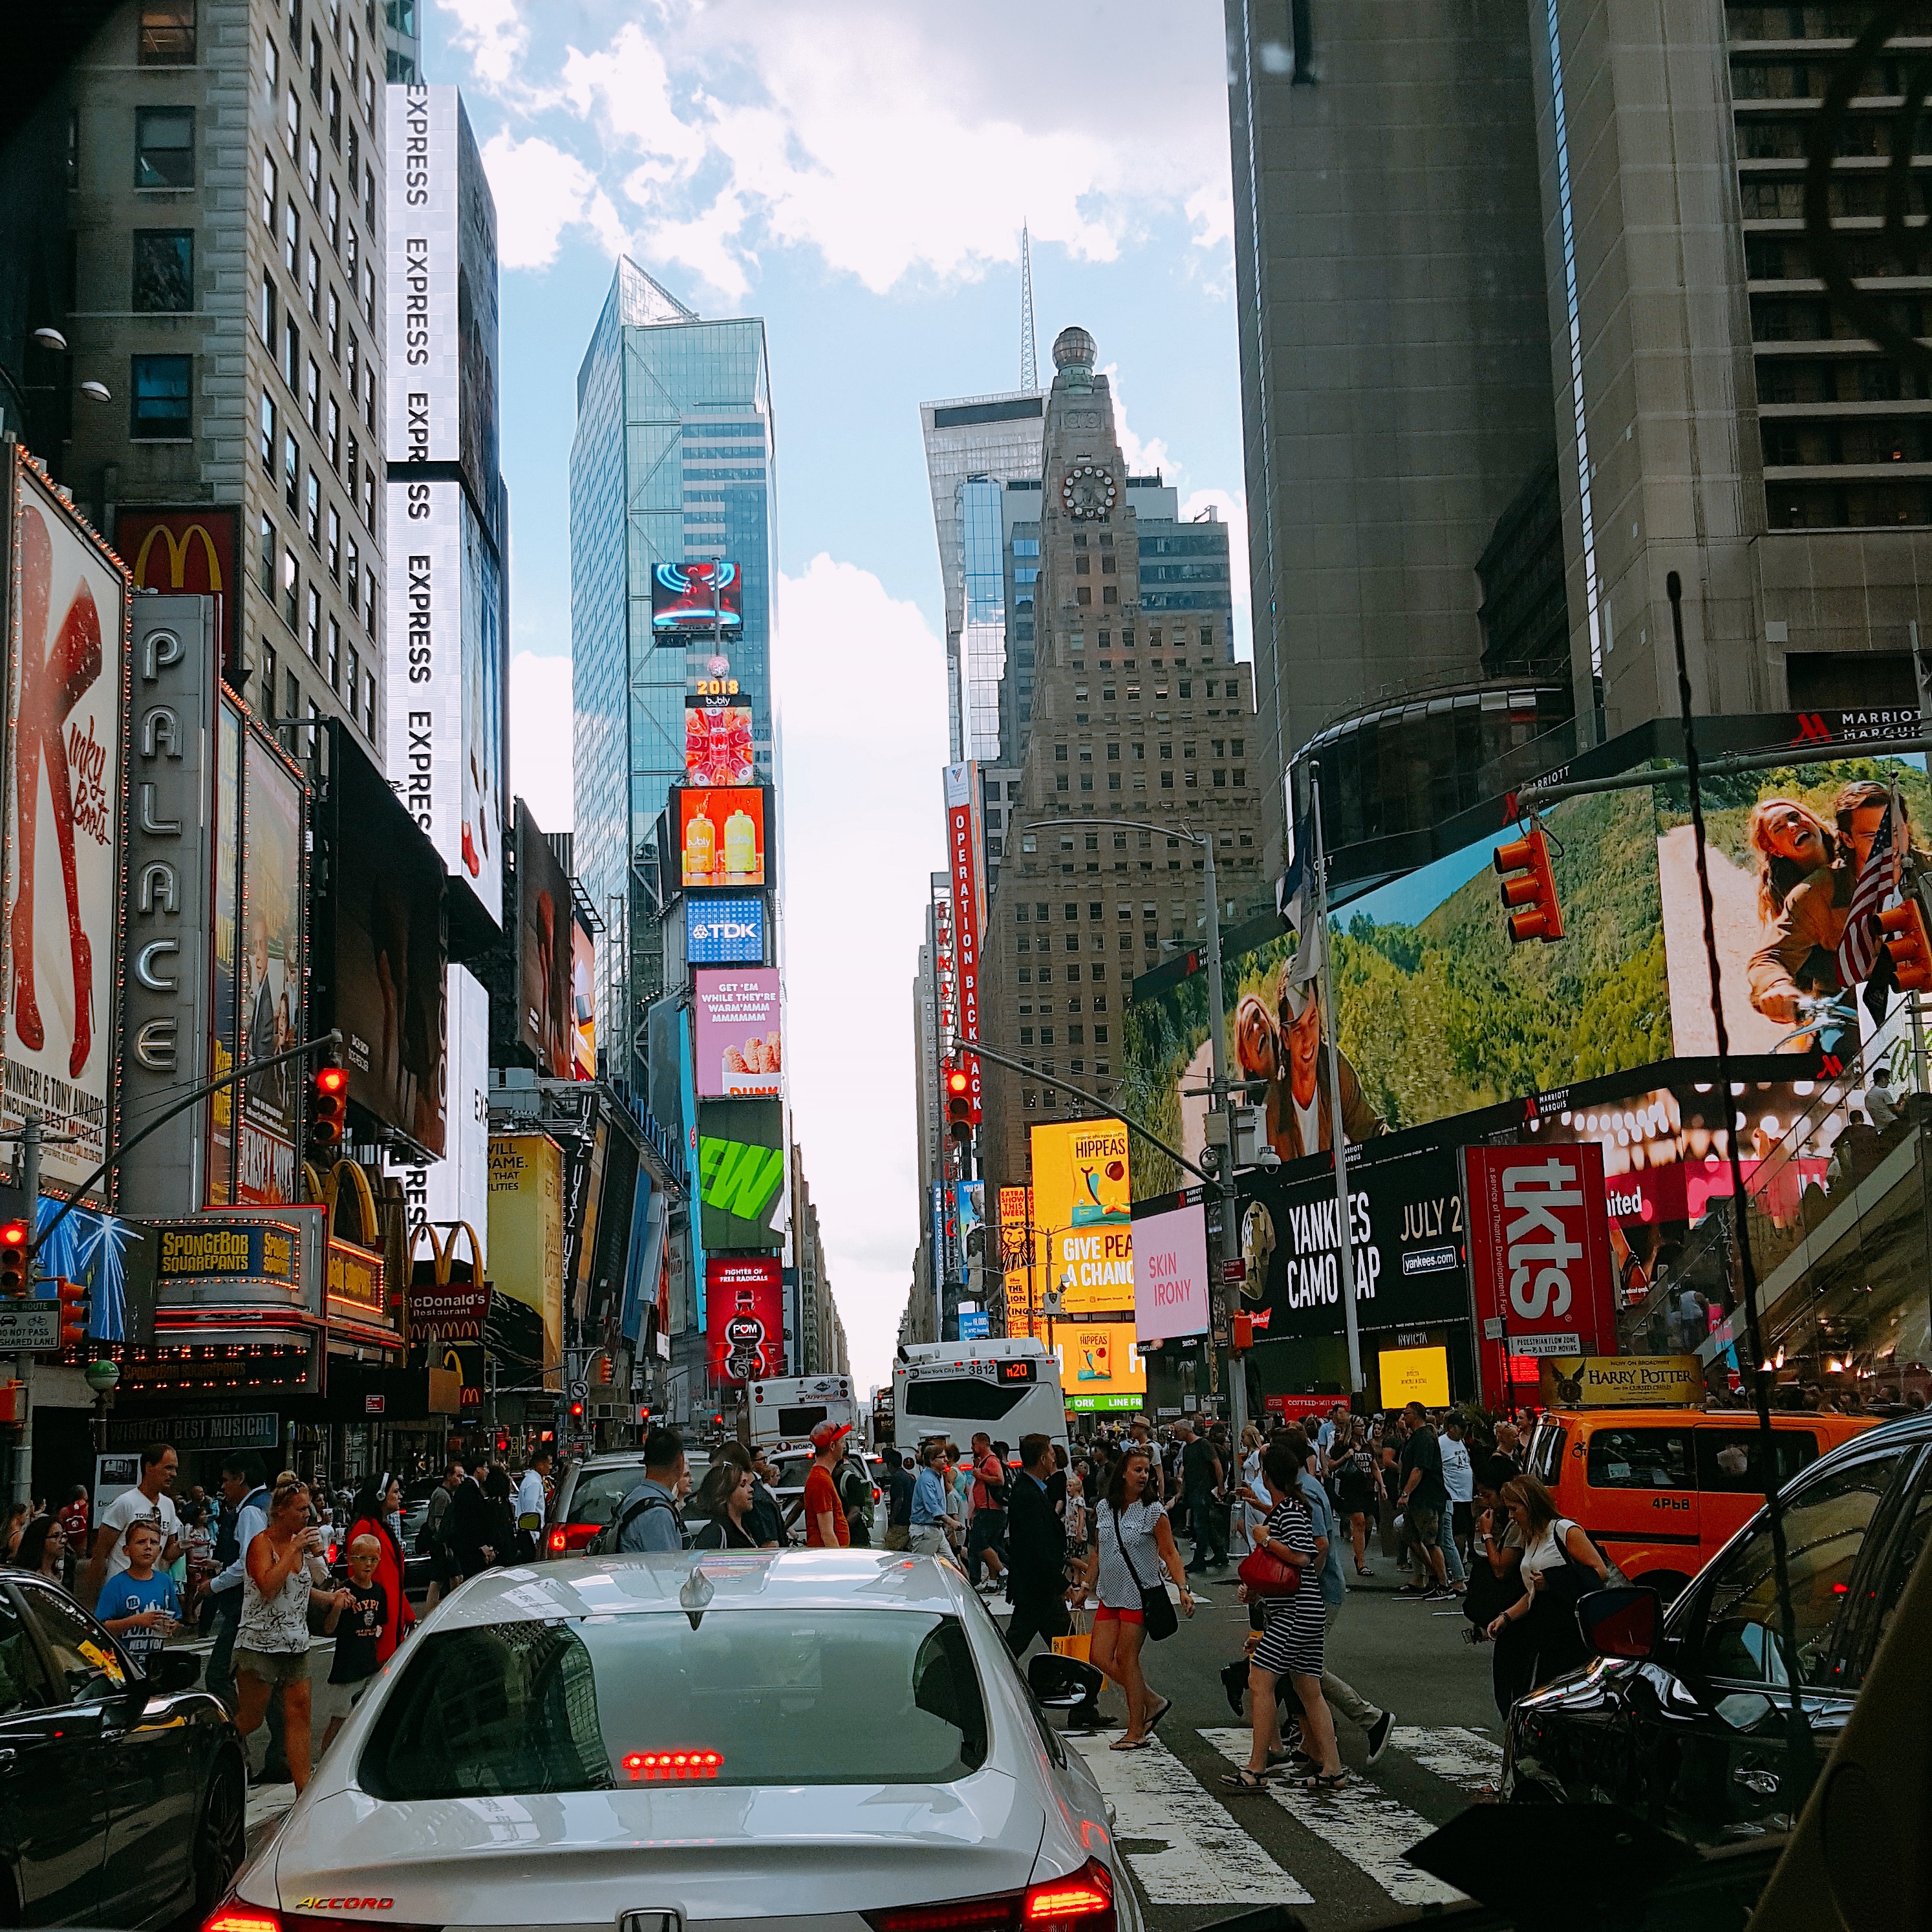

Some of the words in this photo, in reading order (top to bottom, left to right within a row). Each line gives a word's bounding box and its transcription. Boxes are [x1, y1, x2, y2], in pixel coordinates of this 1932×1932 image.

[407, 84, 428, 206] EXPRESS
[407, 239, 429, 366] EXPRESS
[407, 392, 429, 520] EXPRSS
[408, 555, 431, 684] EXPRESS
[696, 680, 739, 695] 2018
[705, 697, 731, 706] bubly
[1842, 711, 1922, 725] MARRIOT
[409, 712, 433, 841] EXPRES
[1533, 766, 1570, 789] ARRIOTT
[73, 779, 112, 845] Boots
[133, 628, 185, 1071] PALACE
[956, 815, 972, 965] OPERATION
[708, 923, 757, 939] TDK
[719, 983, 738, 993] GET
[740, 983, 758, 992] 'EM
[702, 993, 734, 1002] WHILE
[736, 993, 776, 1002] THEY'RE
[708, 1003, 769, 1012] WARM'MMM
[5, 1058, 42, 1102] WINNER!
[43, 1074, 50, 1104] 6
[51, 1077, 72, 1113] TONY
[73, 1088, 104, 1127] AWARDS
[1540, 1089, 1569, 1104] MARRIOTT
[1540, 1100, 1567, 1114] MARQUIS
[3, 1094, 43, 1121] INCLUDING
[45, 1110, 66, 1132] BEST
[69, 1119, 103, 1147] MUSICAL
[1076, 1138, 1126, 1158] HIPPEAS
[1343, 1144, 1363, 1154] ARRIOTT
[1344, 1154, 1361, 1163] ARQUIS
[493, 1172, 521, 1180] THAT
[568, 1165, 583, 1227] MAC
[963, 1184, 974, 1193] YOU
[974, 1182, 985, 1192] CAN
[1490, 1174, 1499, 1203] service
[1002, 1209, 1025, 1218] WEEK
[1491, 1203, 1500, 1212] of
[1400, 1197, 1445, 1241] JULY
[1492, 1213, 1501, 1244] Theatre
[1501, 1157, 1583, 1320] tkts
[1063, 1236, 1101, 1261] GIVE
[163, 1255, 249, 1272] SQUAREPANTS
[1148, 1252, 1177, 1279] SKIN
[1404, 1252, 1454, 1271] yankees.com
[1066, 1263, 1078, 1287] A
[1287, 1252, 1339, 1309] CAMO
[1351, 1245, 1380, 1300] AP
[1495, 1245, 1507, 1297] Development
[1154, 1278, 1191, 1307] IRONY
[23, 1302, 48, 1310] ROUTE
[28, 1327, 49, 1336] PASS
[733, 1324, 757, 1334] POM
[0, 1338, 32, 1346] SHARED
[34, 1337, 56, 1346] LANE
[1080, 1335, 1108, 1345] HIPPEAS
[1398, 1331, 1428, 1346] INVICTA
[969, 1365, 996, 1375] 3812
[1006, 1364, 1027, 1377] M20
[1588, 1369, 1637, 1384] HARRY
[1640, 1369, 1695, 1384] POTTER
[1108, 1398, 1129, 1407] LINE
[173, 1421, 205, 1439] BEST
[210, 1417, 272, 1437] MUSICAL
[295, 1896, 394, 1909] ACCORD
